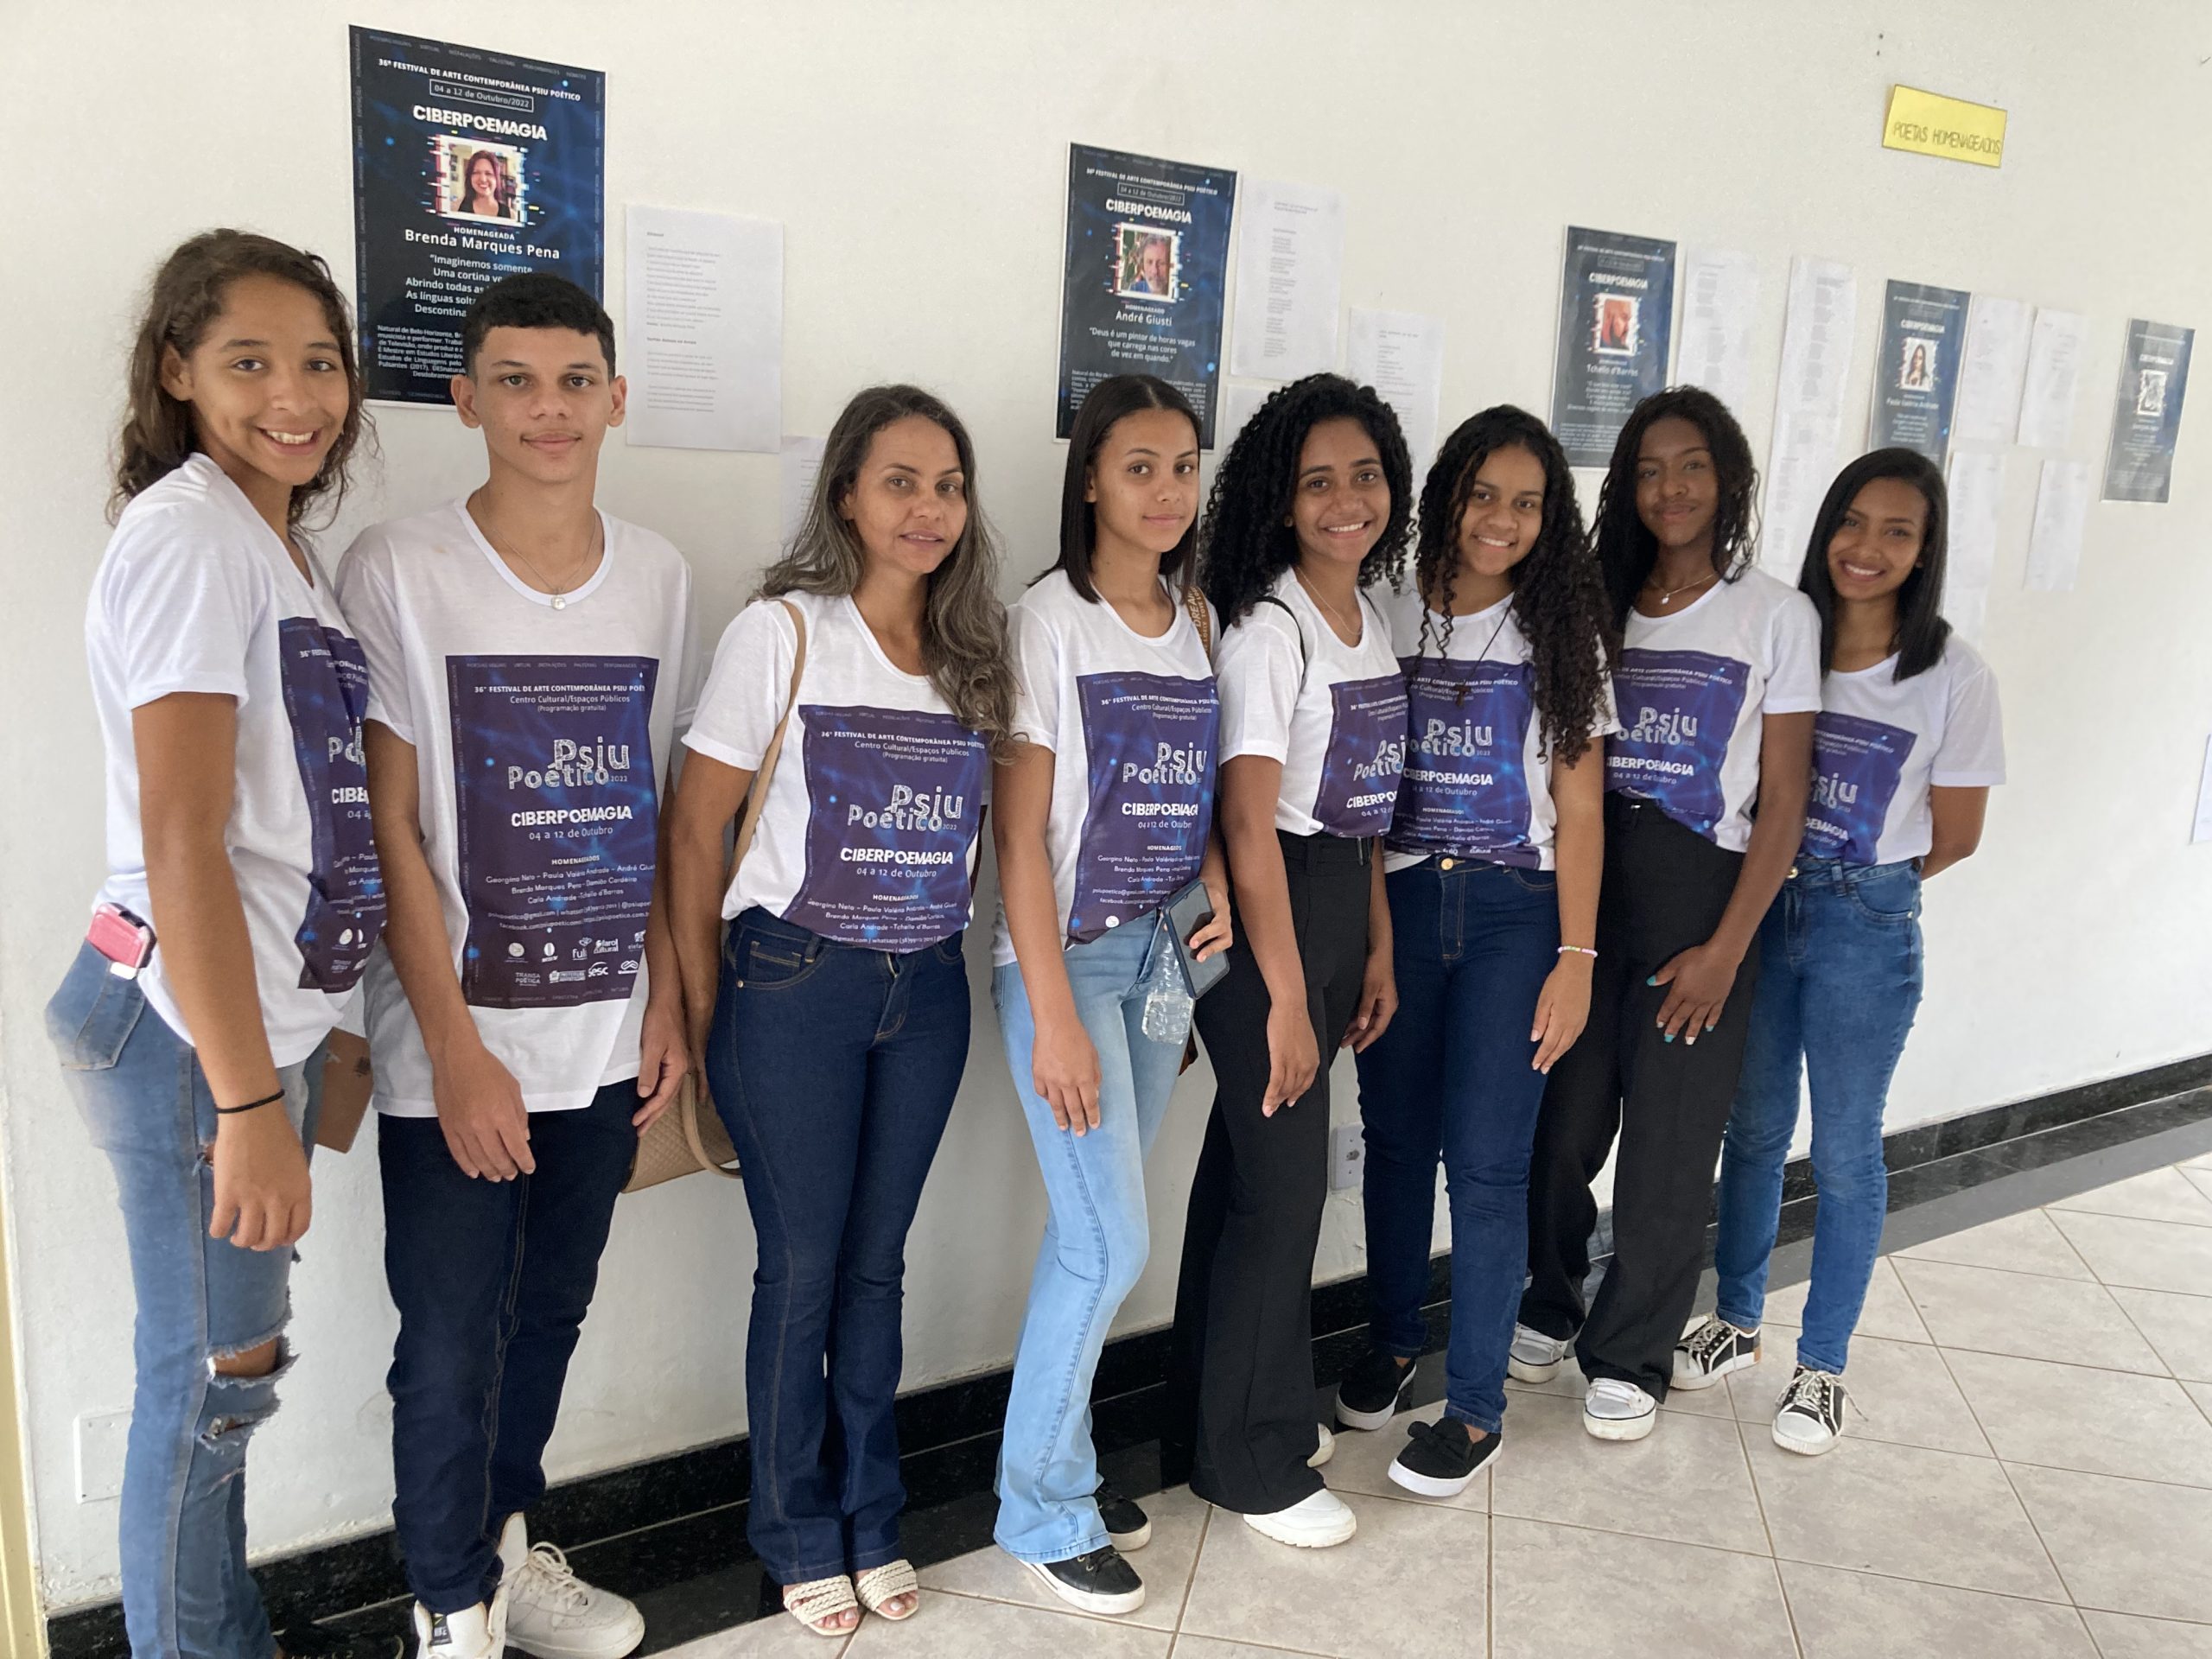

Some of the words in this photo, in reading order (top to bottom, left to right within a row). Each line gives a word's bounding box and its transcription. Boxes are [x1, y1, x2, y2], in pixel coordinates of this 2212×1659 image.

[394, 61, 429, 74] FESTIVAL
[442, 70, 461, 79] ARTE
[464, 74, 530, 92] CONTEMPORÂNEA
[532, 86, 548, 95] PSIU
[550, 88, 581, 101] POÉTICO
[477, 91, 530, 108] Outubro/2022
[413, 105, 548, 141] CIBERPOEMAGIA
[1893, 121, 1929, 143] POETAS
[1933, 128, 2001, 155] HOMENAGEADOS
[1096, 169, 1117, 179] FESTIVAL
[1106, 199, 1192, 224] CIBERPOEMAGIA
[454, 227, 515, 240] HOMENAGEADA
[404, 229, 457, 247] Brenda
[462, 237, 522, 254] Marques
[527, 245, 560, 259] Pena
[434, 268, 455, 278] Uma
[457, 270, 490, 282] cortina
[493, 263, 532, 273] somente
[406, 277, 443, 289] Abrindo
[446, 282, 472, 292] todas
[405, 290, 417, 299] As
[420, 291, 454, 304] línguas
[1116, 310, 1143, 323] André
[1146, 315, 1173, 327] Giusti
[1128, 332, 1147, 340] pintor
[1159, 335, 1176, 344] horas
[1122, 342, 1146, 352] carrega
[537, 695, 598, 703] Cultural/Espaços
[1639, 707, 1697, 737] Psiu
[896, 735, 950, 745] CONTEMPORÂNEA
[1425, 719, 1492, 747] Psiu
[553, 736, 631, 770] Psiu
[855, 741, 880, 749] Centro
[883, 743, 939, 754] Cultural/Espaços
[1375, 735, 1406, 764] Psi
[1156, 742, 1207, 772] Psiu
[508, 762, 609, 790] Poético
[1123, 760, 1197, 785] Poético
[1445, 787, 1478, 796] Outubro
[891, 785, 963, 819] Psiu
[347, 810, 360, 819] 04
[511, 806, 632, 827] CIBERPOEMAGIA
[848, 804, 943, 832] Poético
[529, 832, 541, 842] 04
[568, 829, 580, 838] de
[582, 826, 613, 836] Outubro
[840, 847, 953, 865] CIBERPOEMAGIA
[891, 868, 903, 877] de
[905, 869, 937, 878] Outubro
